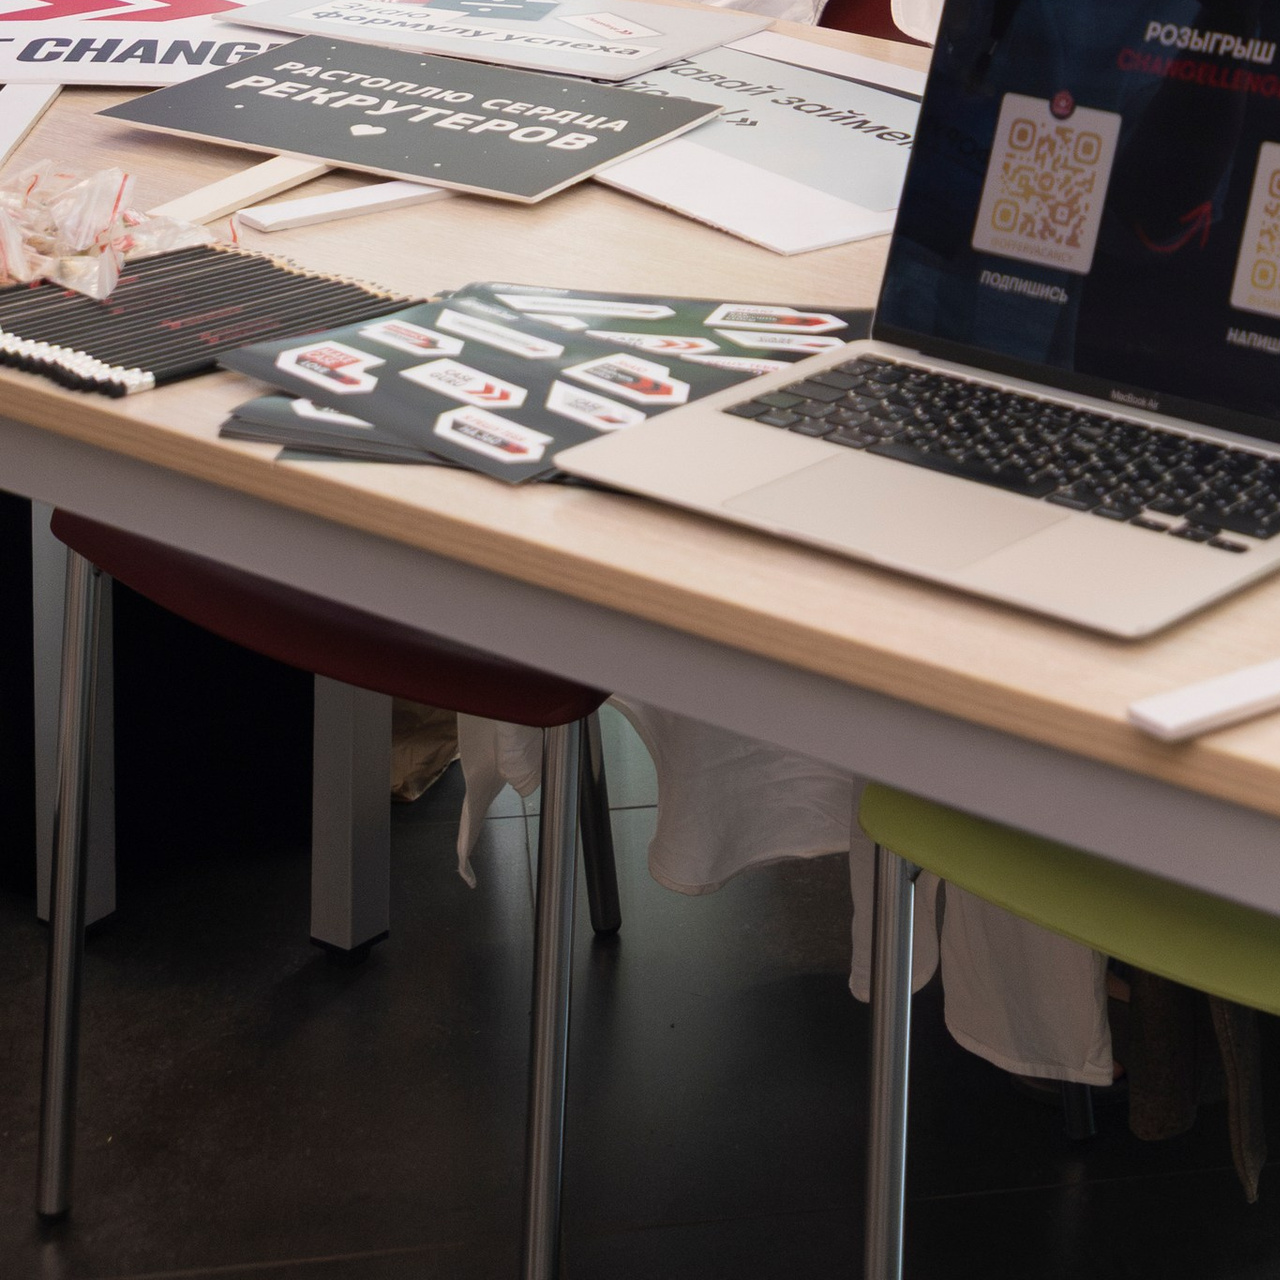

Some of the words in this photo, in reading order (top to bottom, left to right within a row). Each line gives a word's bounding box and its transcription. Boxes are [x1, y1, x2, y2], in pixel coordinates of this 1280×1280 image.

[311, 9, 494, 40] формулу
[493, 32, 642, 57] успеха
[340, 2, 432, 20] Знаю
[15, 37, 293, 68] CHANG
[1144, 20, 1278, 65] РОЗЫГРЫШ
[225, 73, 599, 151] РЕКРУТЕРОВ
[273, 60, 476, 104] РАСТОПЛЮ
[481, 97, 630, 133] СЕРДЦА
[770, 94, 915, 150] займе
[979, 268, 1069, 305] ПОДПИШИСЬ
